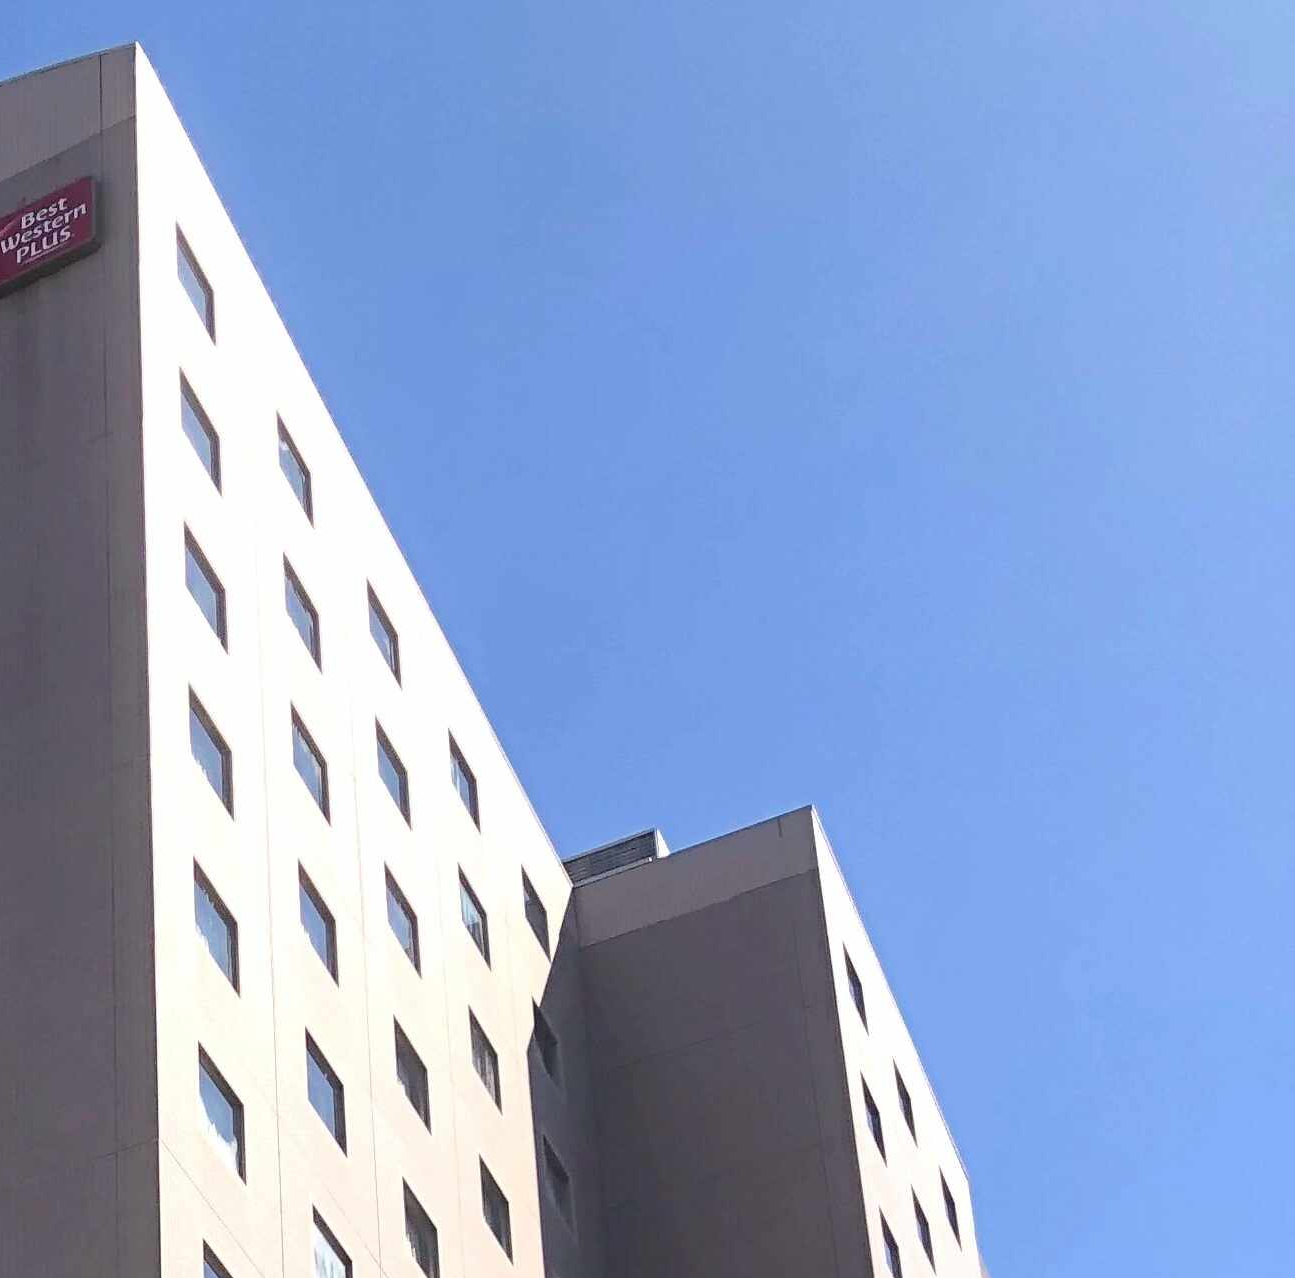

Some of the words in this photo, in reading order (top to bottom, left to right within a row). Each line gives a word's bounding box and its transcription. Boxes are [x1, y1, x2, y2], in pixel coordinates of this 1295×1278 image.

[0, 203, 87, 255] Western
[20, 197, 67, 230] Best
[16, 227, 71, 265] PLUS
